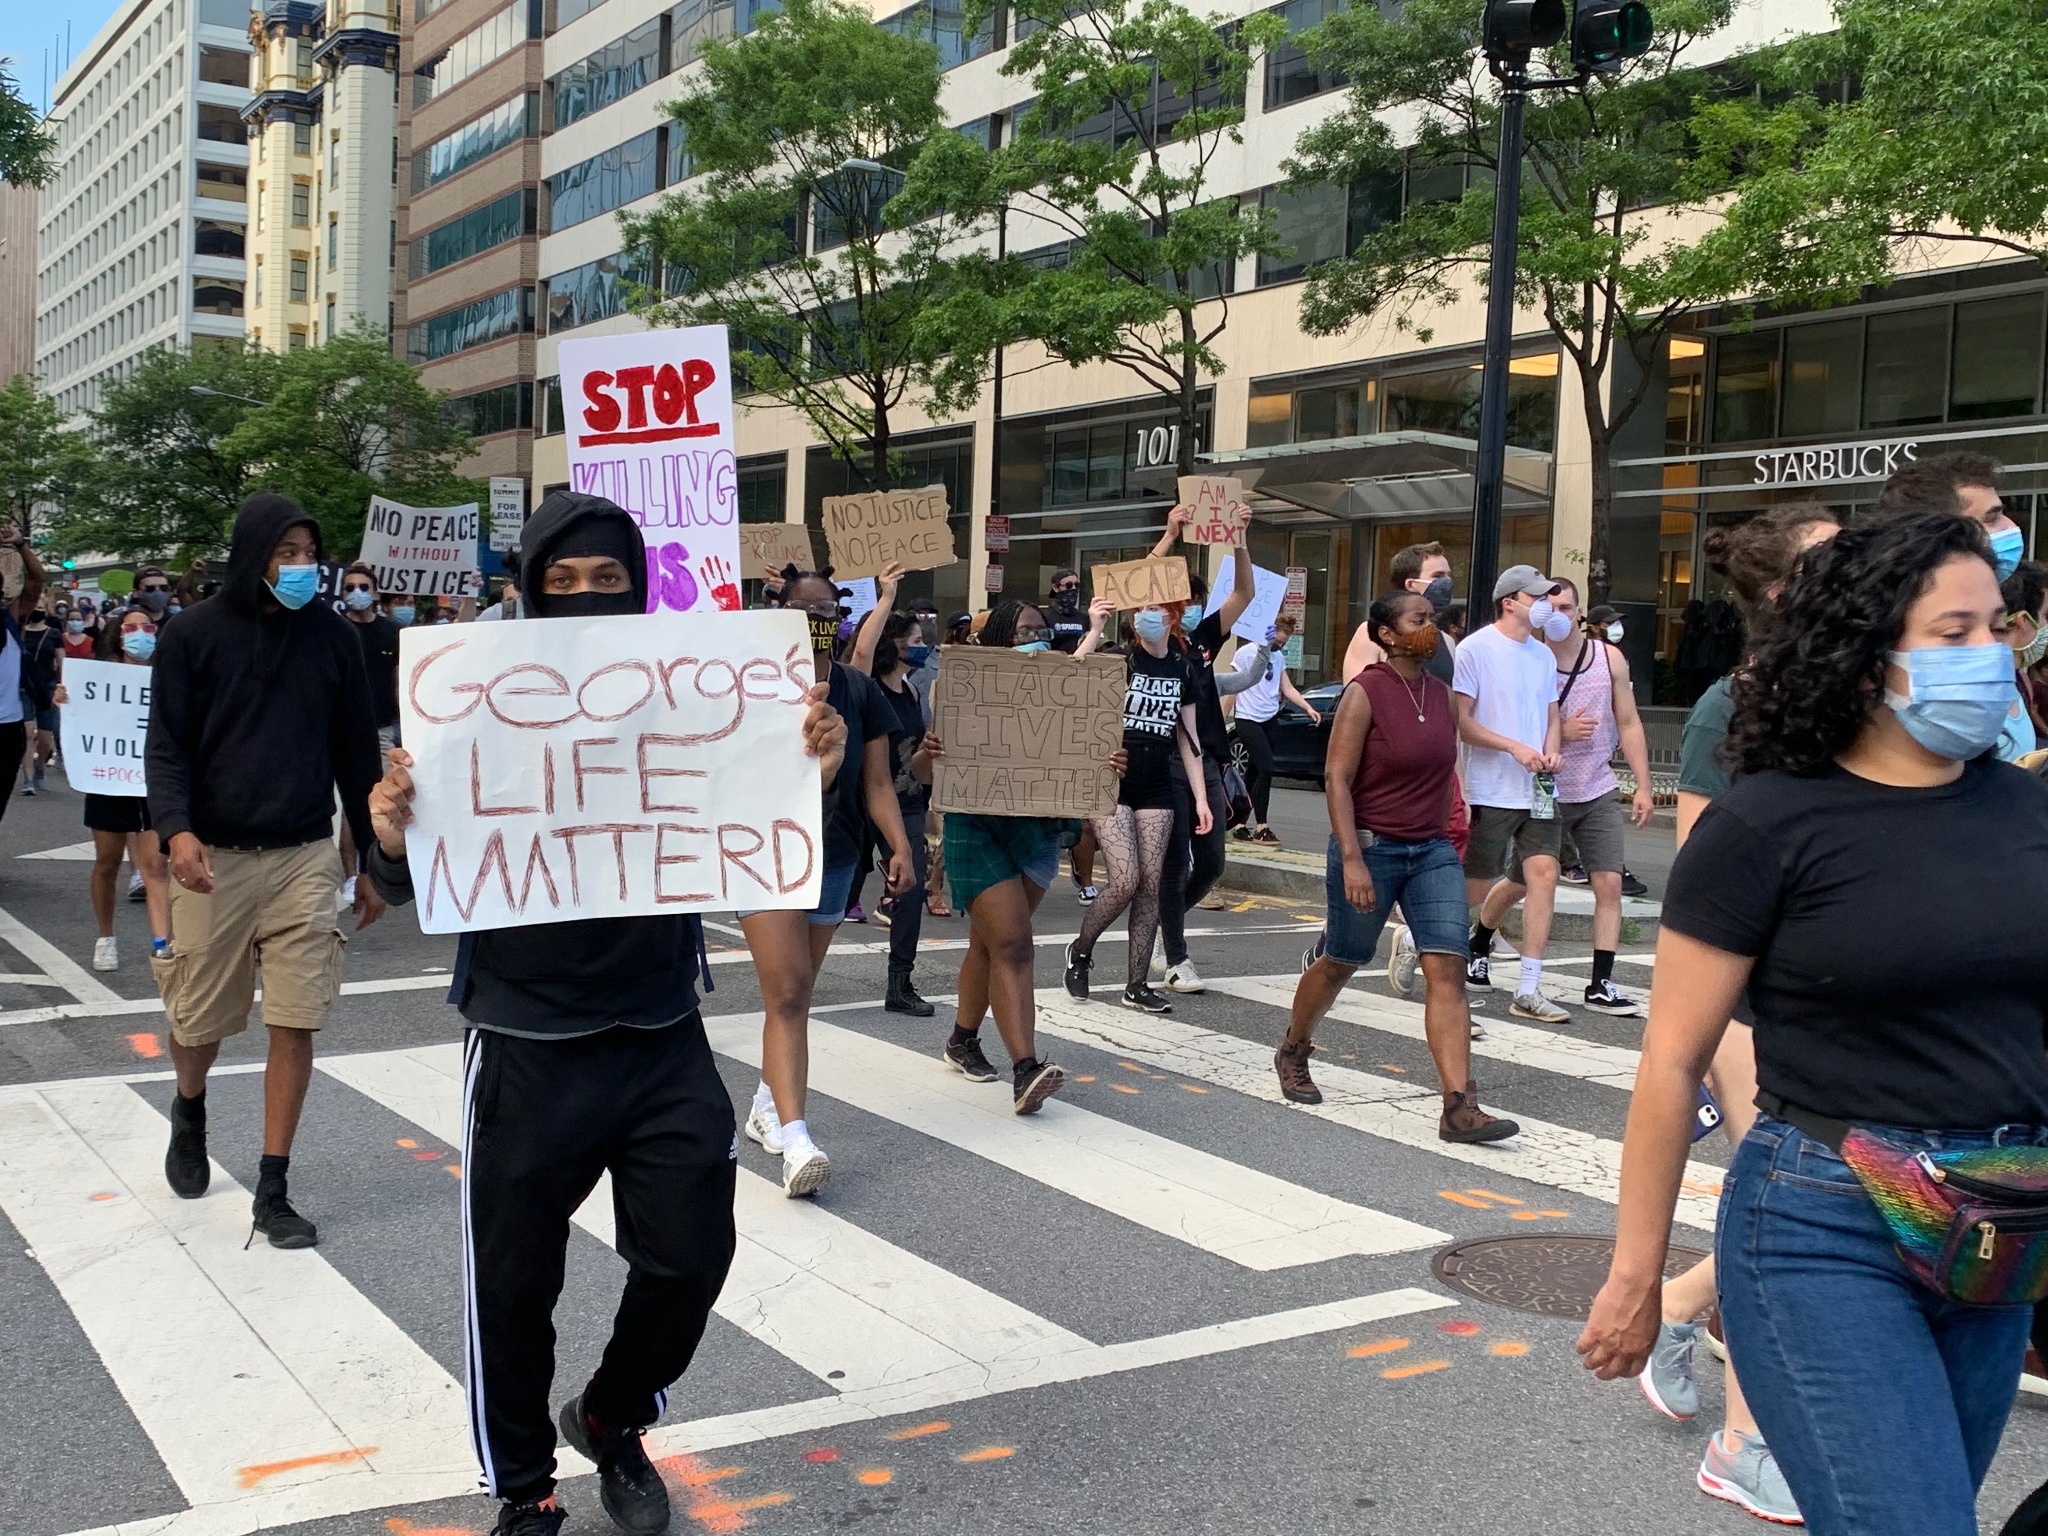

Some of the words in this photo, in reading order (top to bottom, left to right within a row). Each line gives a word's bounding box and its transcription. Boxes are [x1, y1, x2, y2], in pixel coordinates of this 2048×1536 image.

[582, 359, 716, 432] STOP
[1136, 424, 1200, 467] 101
[1753, 442, 1918, 485] STARBUCKS
[493, 488, 520, 496] SUMMIT
[497, 502, 517, 511] FOR
[1198, 480, 1227, 505] AM
[370, 504, 403, 537] NO
[409, 511, 478, 541] PEACE
[491, 511, 522, 520] LEASE
[831, 503, 863, 533] NO
[863, 495, 942, 528] JUSTICE
[1209, 506, 1222, 523] I
[740, 528, 783, 545] STOP
[1195, 524, 1245, 547] NEXT
[388, 544, 461, 562] WITHOUT
[832, 537, 866, 571] NO
[866, 532, 940, 565] PEACE
[371, 564, 473, 596] USTICE
[1103, 561, 1189, 607] ACAB
[810, 636, 833, 650] TTER
[820, 620, 839, 635] LIVE
[84, 681, 152, 706] SILE
[409, 638, 812, 743] George's
[945, 658, 1125, 709] BLACK
[1131, 676, 1182, 696] BLACK
[1124, 691, 1182, 722] LIVES
[81, 734, 143, 759] VIOL
[942, 704, 1120, 761] LIVES
[92, 766, 146, 785] #POCS
[469, 733, 710, 818] LIFE
[940, 764, 1118, 811] MATTER
[425, 817, 815, 926] MATTERD
